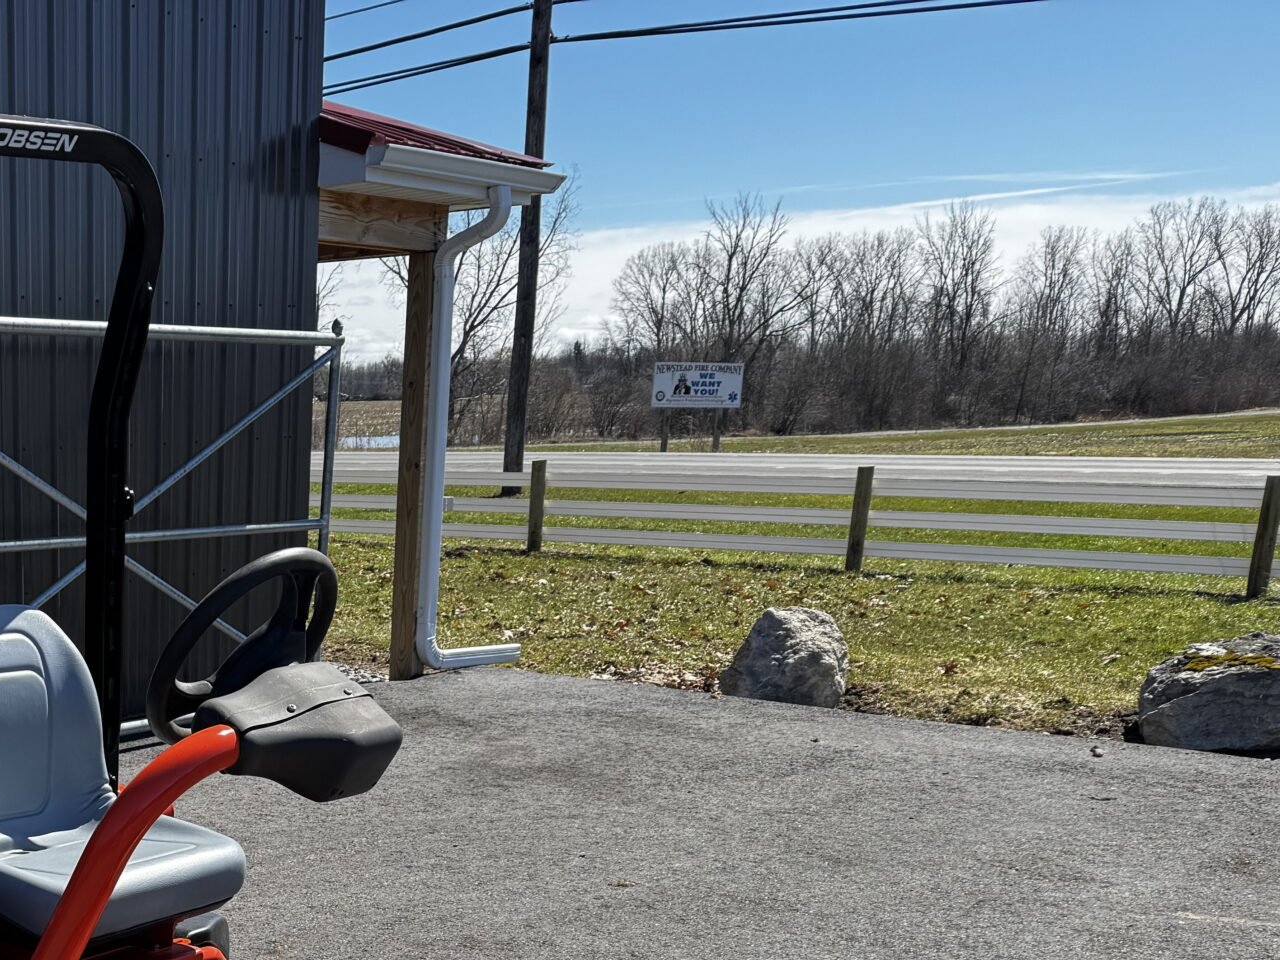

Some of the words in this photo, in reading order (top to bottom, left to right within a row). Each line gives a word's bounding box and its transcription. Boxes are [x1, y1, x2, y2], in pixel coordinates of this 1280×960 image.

[656, 364, 694, 375] NEWSTEAD
[694, 364, 710, 373] FIRE
[710, 364, 743, 376] COMPANY
